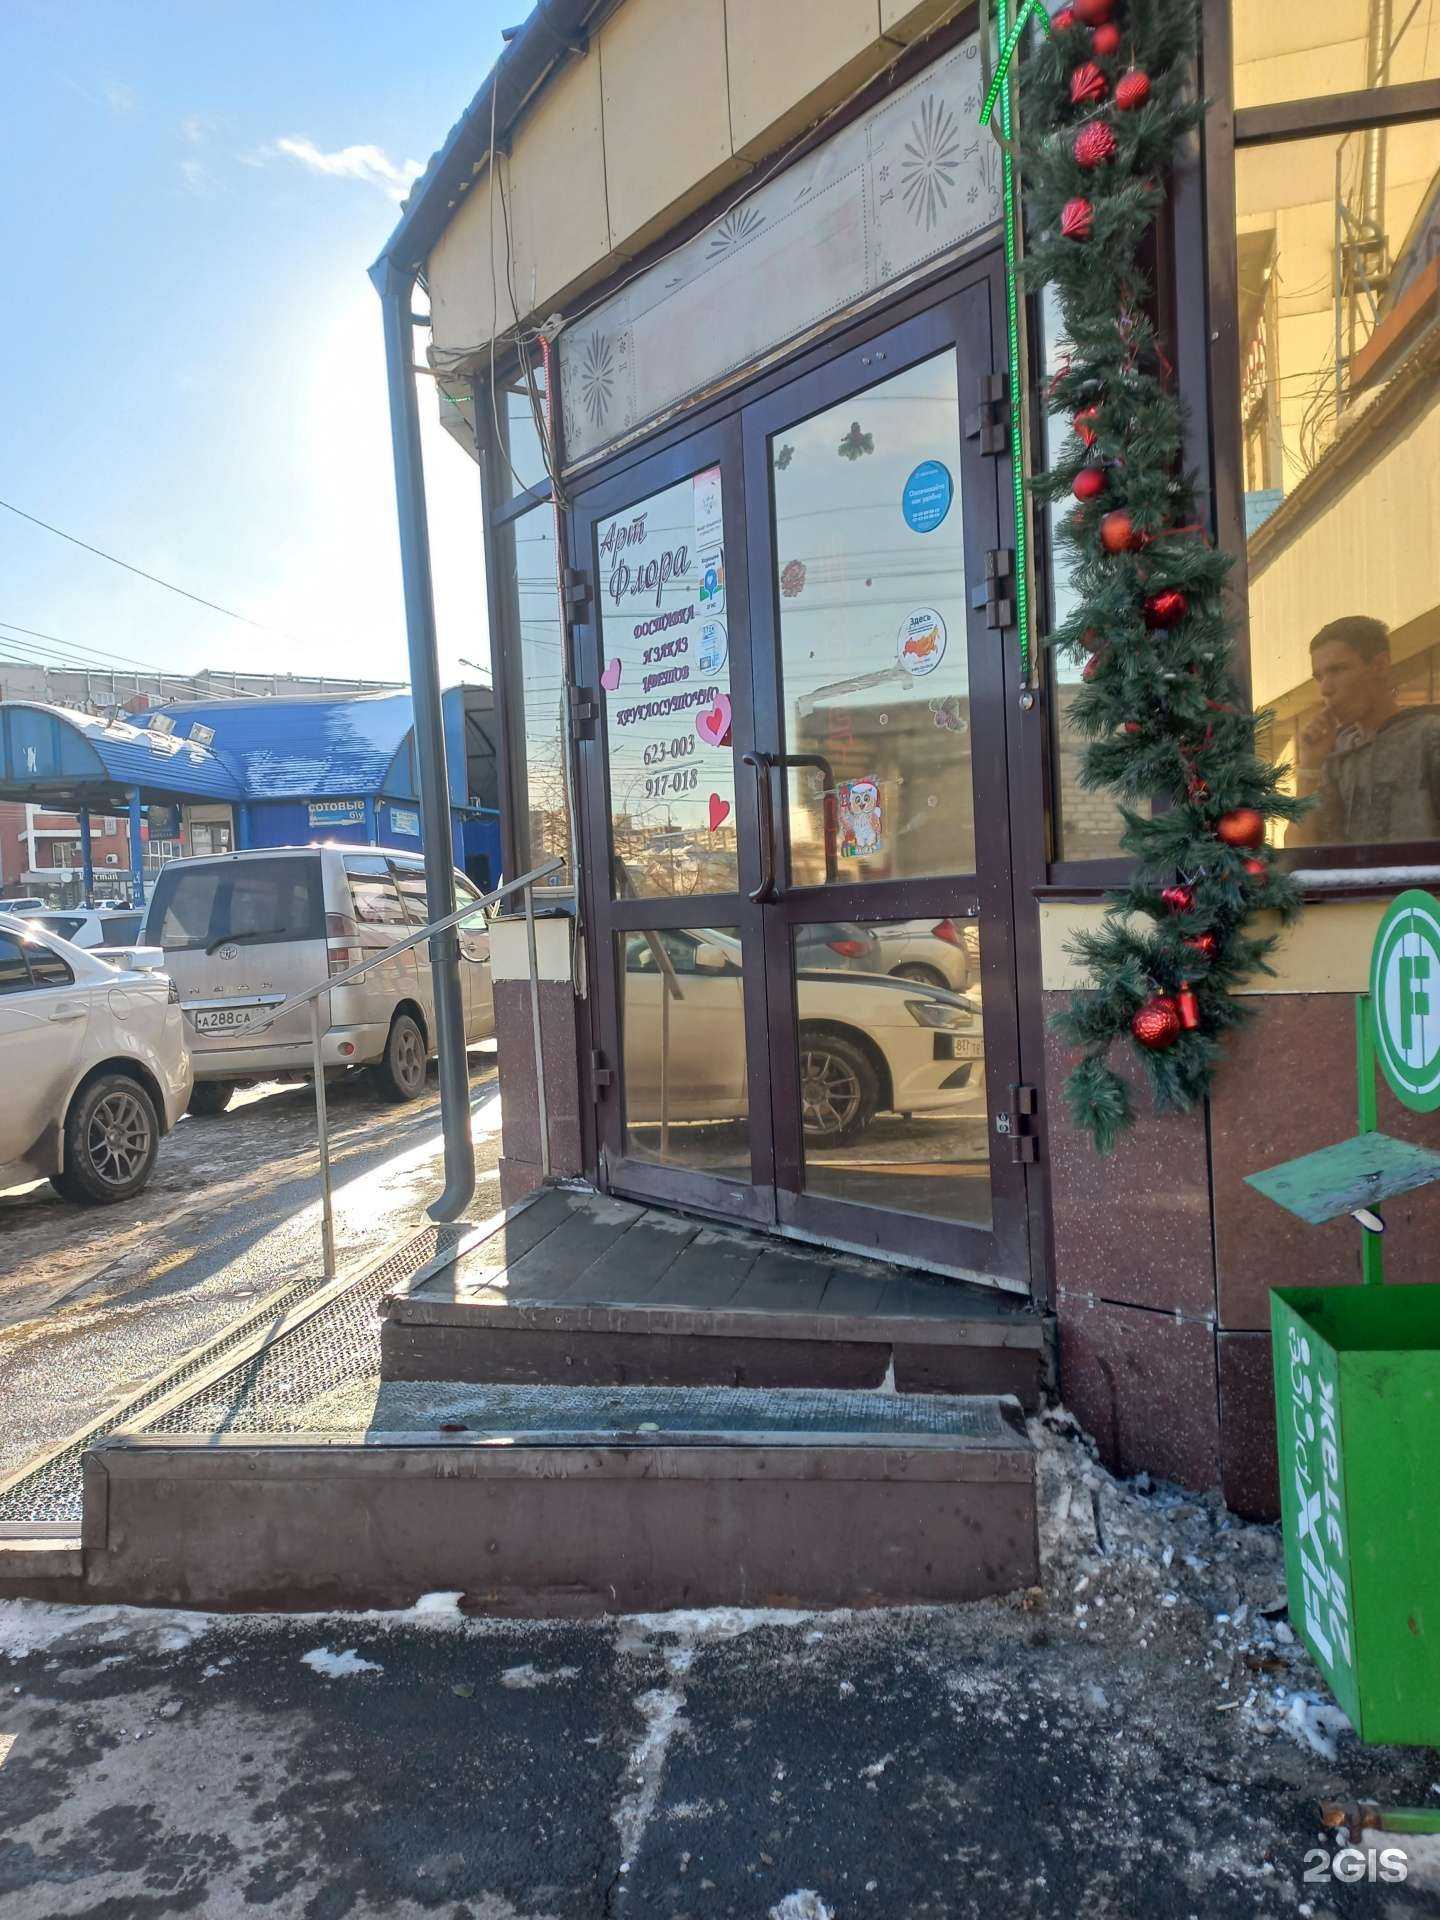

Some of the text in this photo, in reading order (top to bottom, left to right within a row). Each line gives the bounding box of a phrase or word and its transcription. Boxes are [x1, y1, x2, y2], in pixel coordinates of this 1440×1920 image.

[609, 545, 692, 608] Флора
[910, 615, 931, 626] Здесь
[643, 734, 695, 765] 623-003
[645, 768, 698, 799] 917-018
